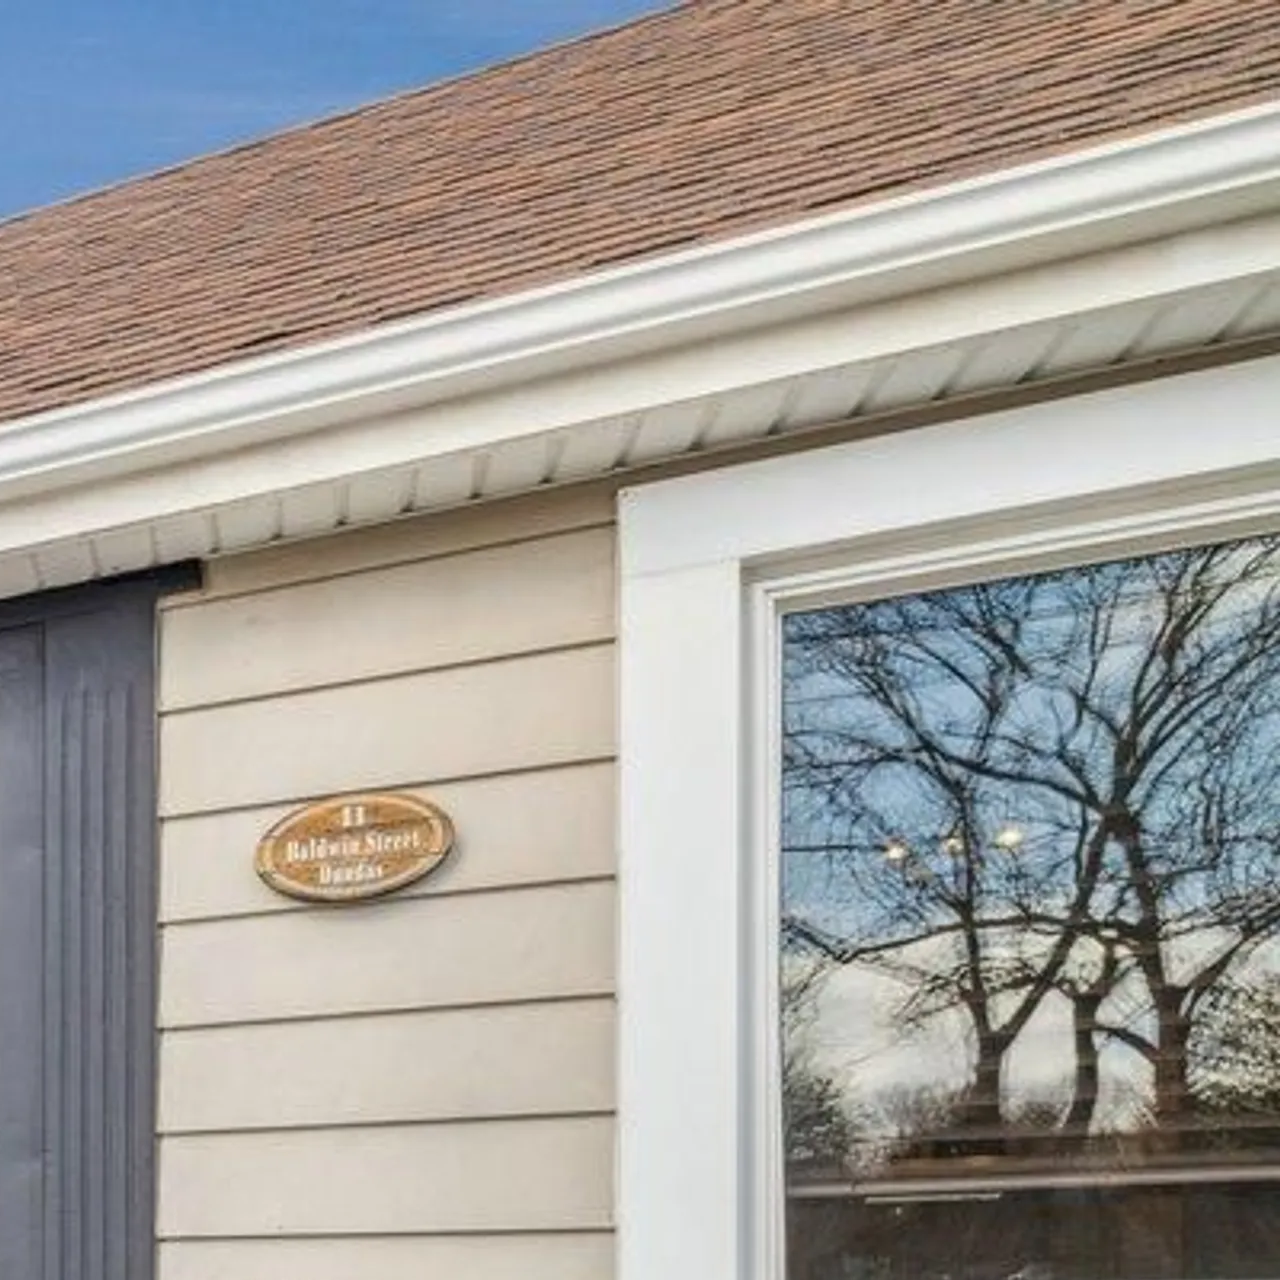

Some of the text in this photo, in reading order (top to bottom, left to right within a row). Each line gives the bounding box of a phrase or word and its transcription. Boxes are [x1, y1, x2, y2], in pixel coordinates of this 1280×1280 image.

[286, 829, 420, 862] Baldwin Street
[319, 862, 383, 885] Dundas
